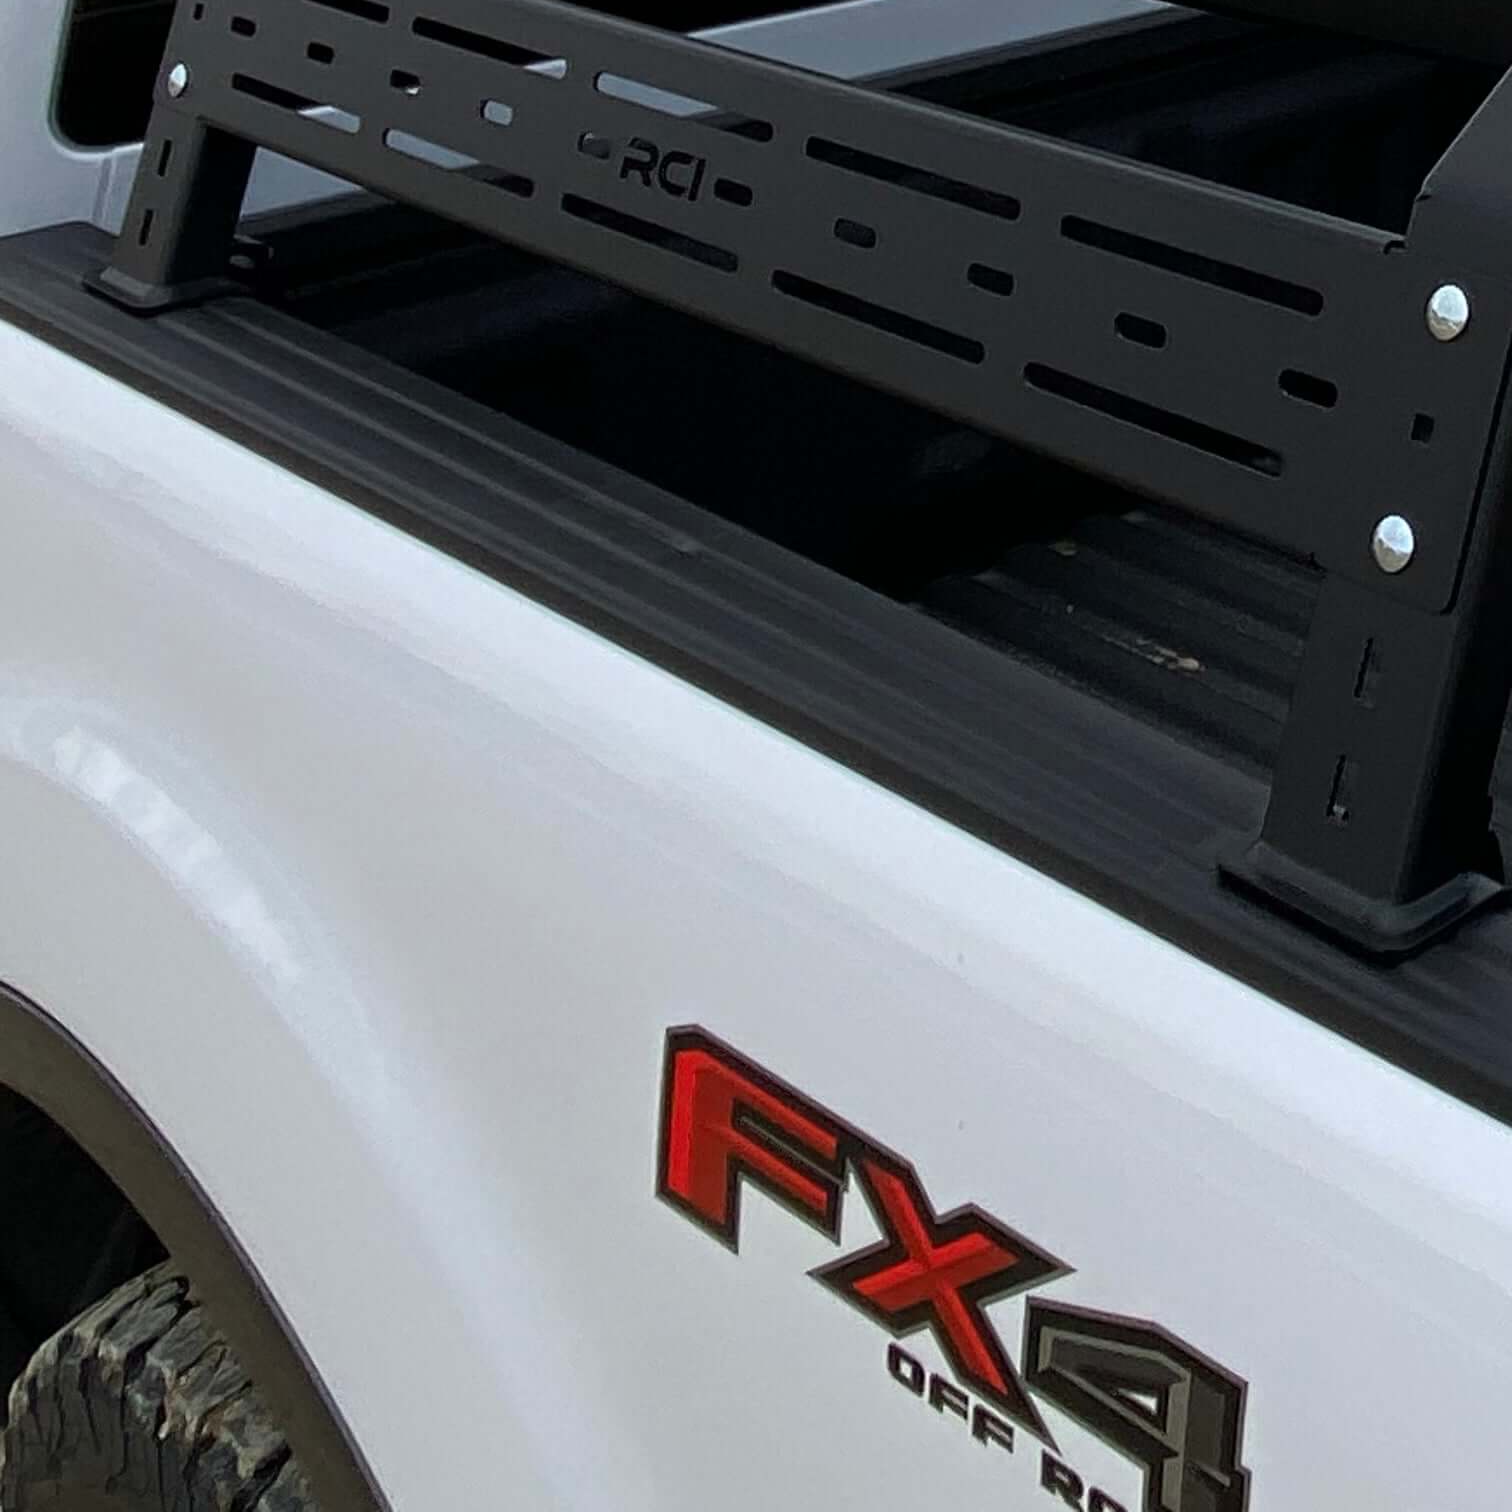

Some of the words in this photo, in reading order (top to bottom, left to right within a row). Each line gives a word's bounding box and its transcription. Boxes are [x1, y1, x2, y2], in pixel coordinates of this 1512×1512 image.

[619, 136, 706, 202] RCI
[655, 1023, 1252, 1512] FX4
[886, 1341, 1014, 1454] OFF
